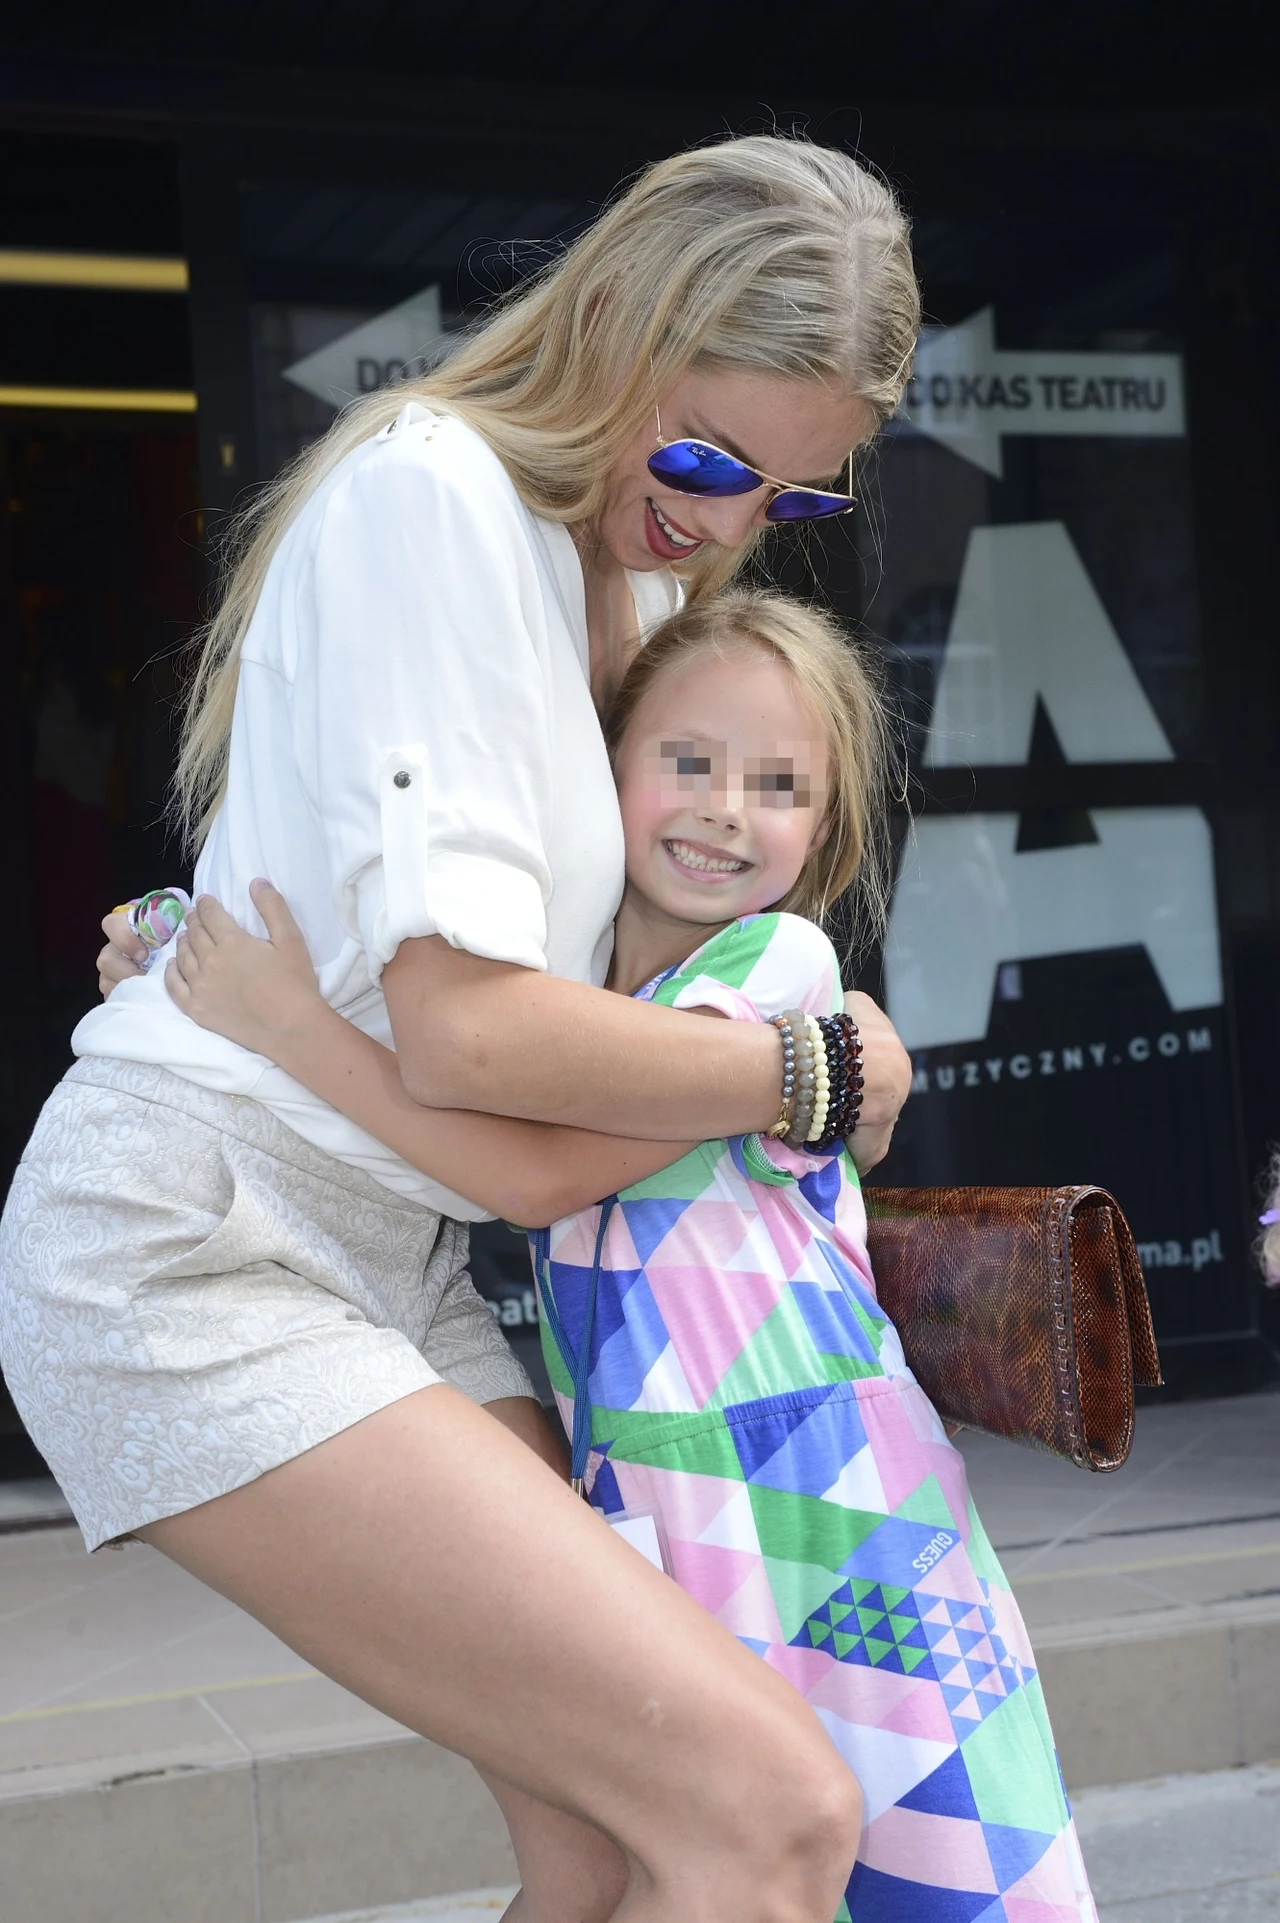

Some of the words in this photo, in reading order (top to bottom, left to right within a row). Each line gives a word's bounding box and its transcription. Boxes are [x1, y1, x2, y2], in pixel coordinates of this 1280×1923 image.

[960, 373, 1032, 412] KAS
[1037, 374, 1167, 413] TEATRU
[910, 1028, 1212, 1093] MUZYCZNY.COM
[912, 1531, 954, 1574] GUESS
